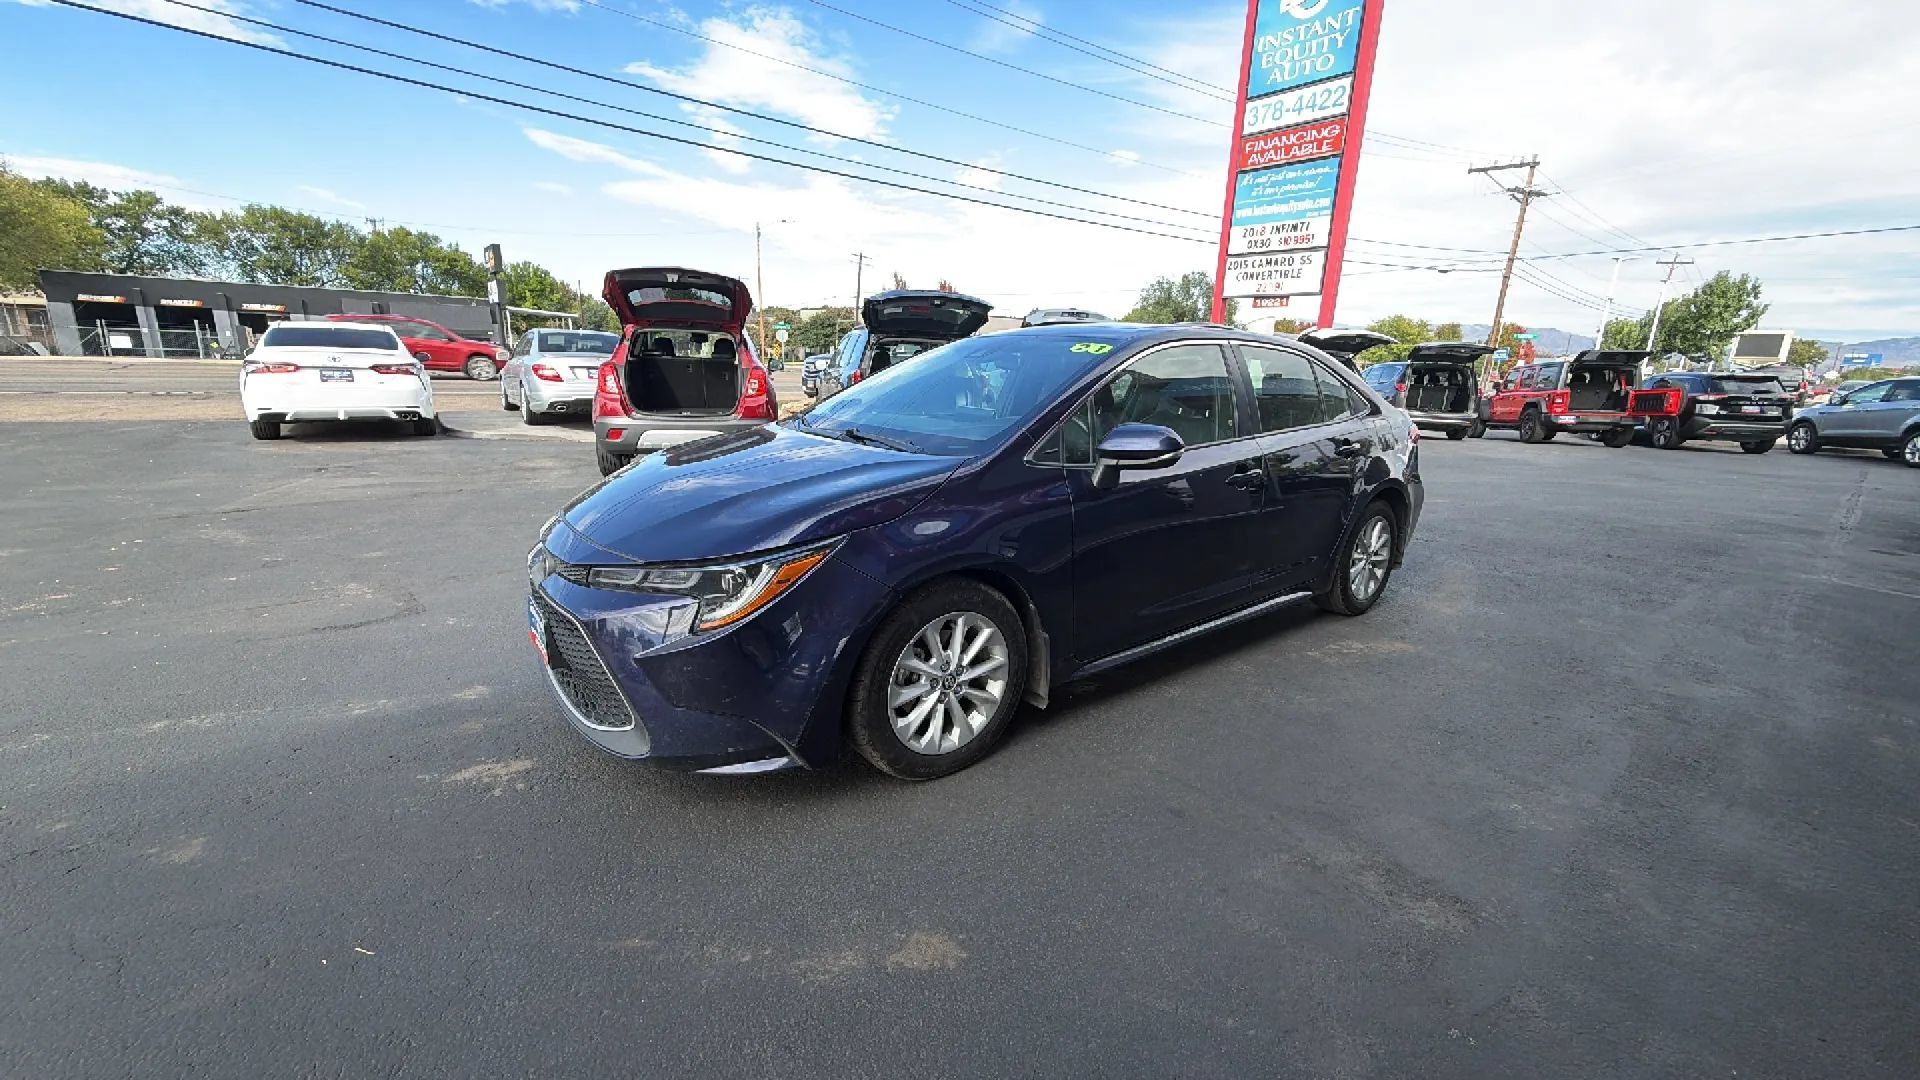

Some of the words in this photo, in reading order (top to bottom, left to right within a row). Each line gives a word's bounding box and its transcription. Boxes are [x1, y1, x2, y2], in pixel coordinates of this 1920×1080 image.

[1257, 7, 1361, 53] INSTANT
[1262, 28, 1351, 69] EQUITY
[1267, 54, 1336, 85] AUTO
[1248, 85, 1347, 127] 378-4422
[1245, 125, 1341, 153] FINANCING
[1248, 140, 1334, 165] AVAILABLE
[1242, 225, 1266, 238] 2018
[1270, 221, 1311, 235] INFINITI
[1228, 259, 1249, 271] 2015
[1252, 256, 1294, 269] CAMARO
[1300, 254, 1313, 265] SS
[1235, 268, 1303, 282] CONVERTIBLE
